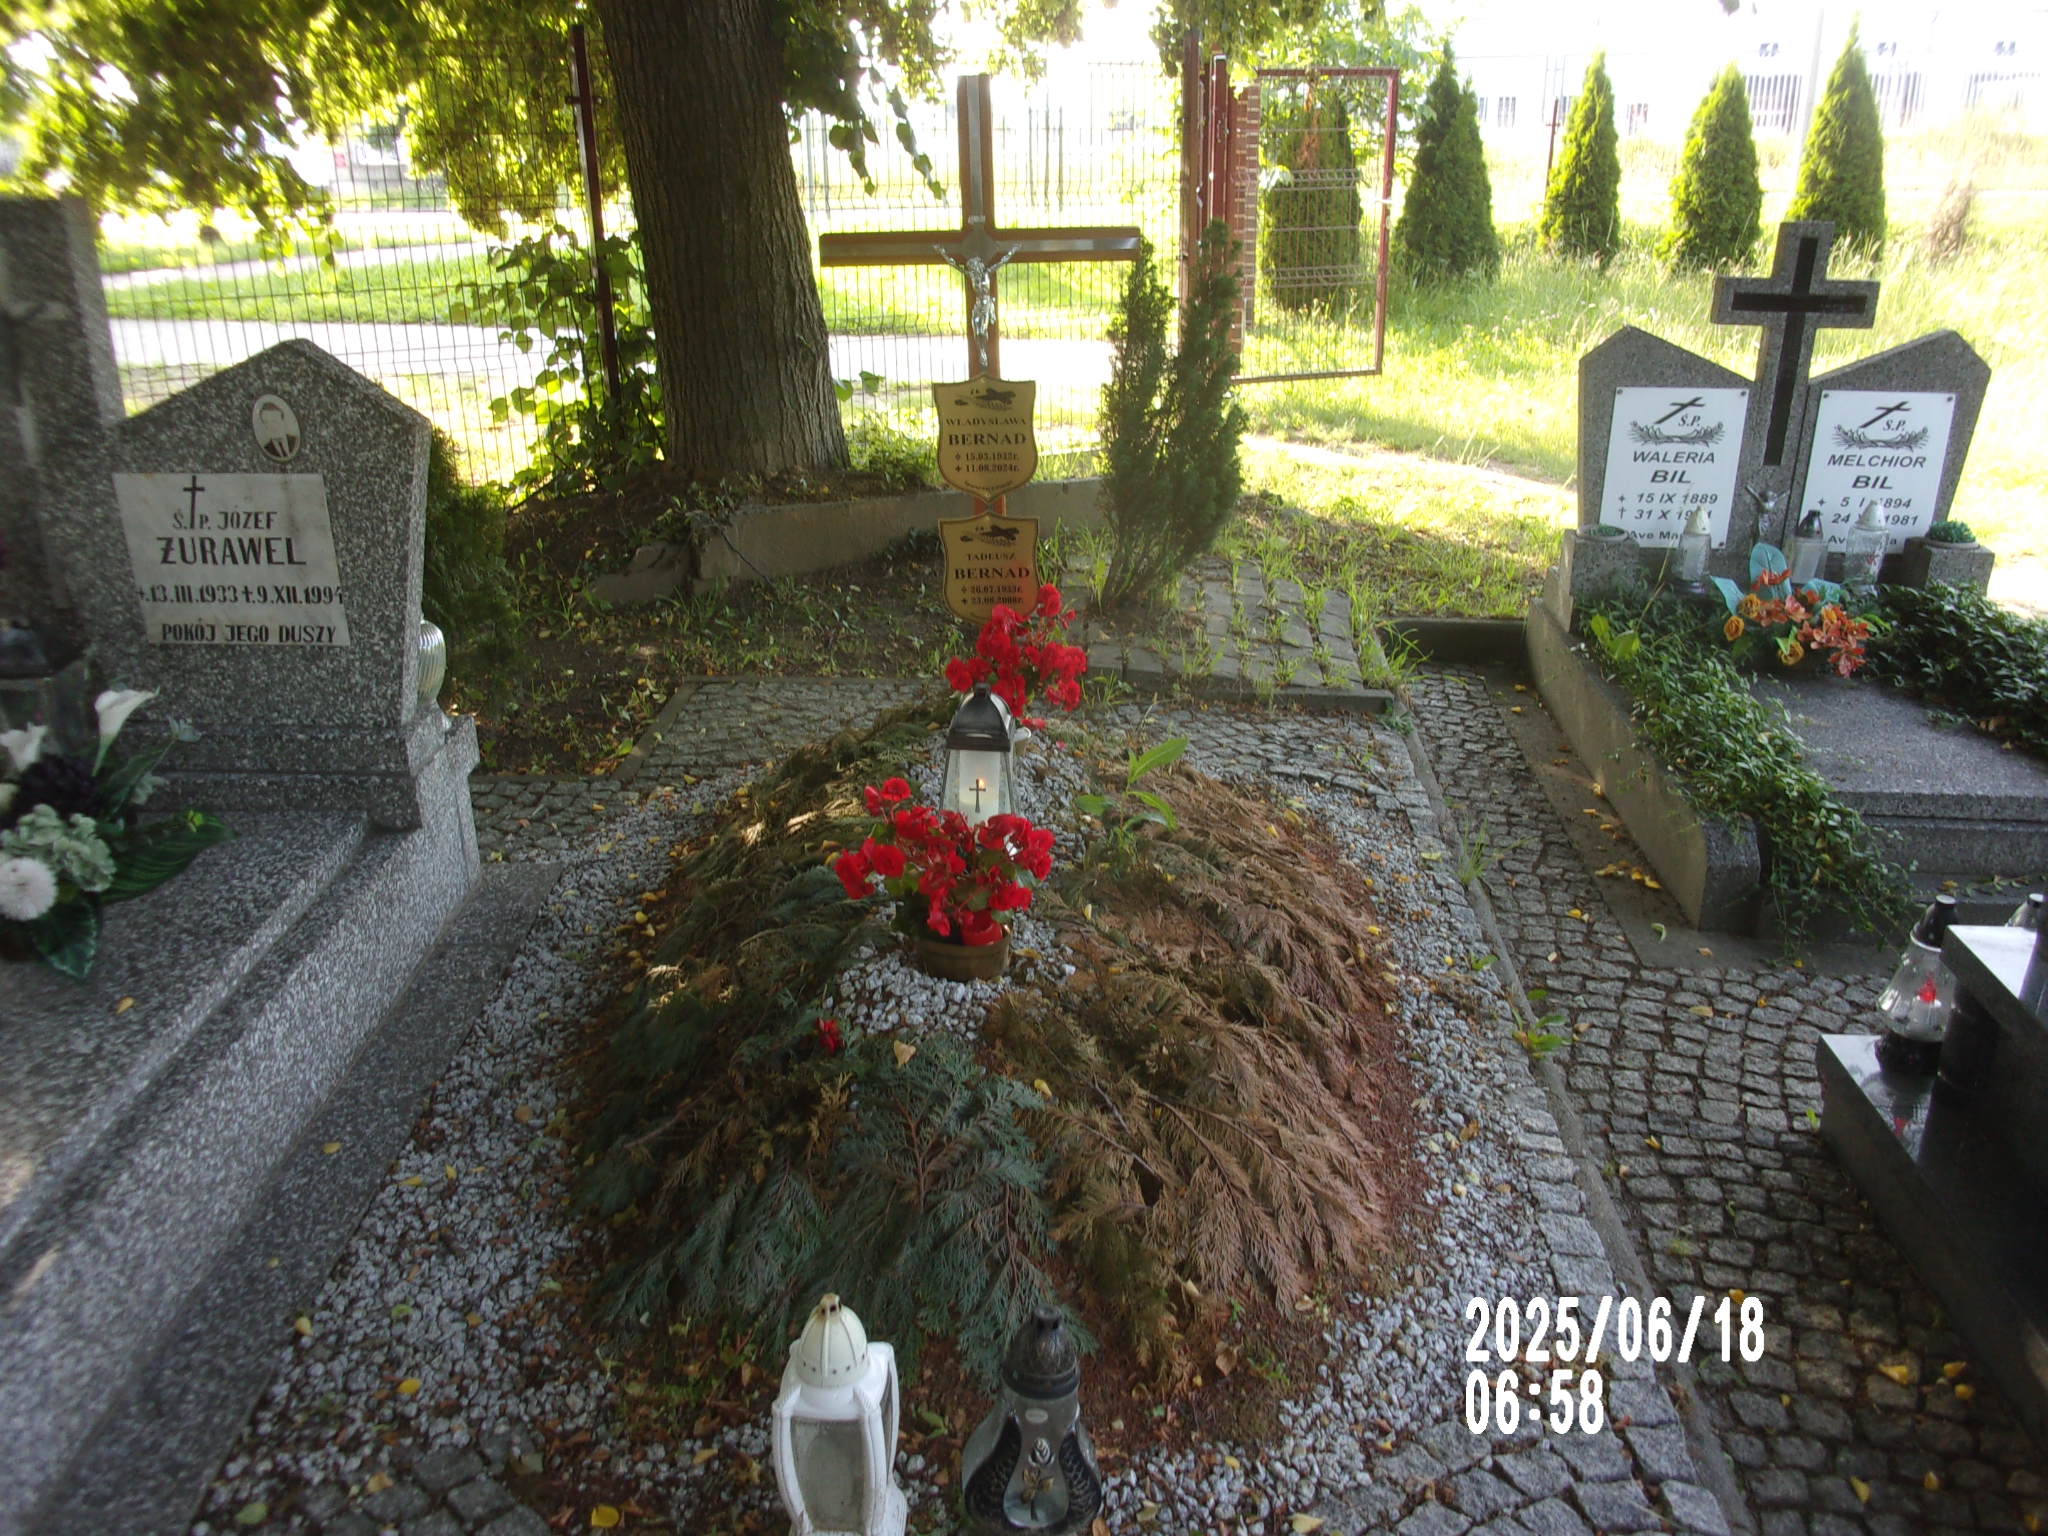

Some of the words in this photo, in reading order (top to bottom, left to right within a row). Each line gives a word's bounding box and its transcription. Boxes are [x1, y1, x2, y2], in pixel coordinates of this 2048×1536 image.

[949, 432, 1028, 446] BERNAD
[1633, 450, 1716, 465] WALERIA
[1827, 453, 1927, 469] MELCHIOR
[1651, 469, 1692, 484] BIL
[1851, 475, 1894, 489] BIL
[1637, 493, 1651, 505] 15
[1659, 493, 1676, 505] IX
[1681, 493, 1719, 505] 1889
[1840, 496, 1850, 508] 5
[1878, 496, 1912, 509] 894
[217, 505, 278, 530] JÓZEF
[1635, 509, 1651, 521] 31
[1676, 509, 1713, 521] 191
[1831, 512, 1850, 525] 24
[954, 567, 1031, 580] BERNAD
[161, 617, 215, 643] POKÓJ
[224, 624, 269, 643] JEGO
[278, 624, 337, 643] DUSZY
